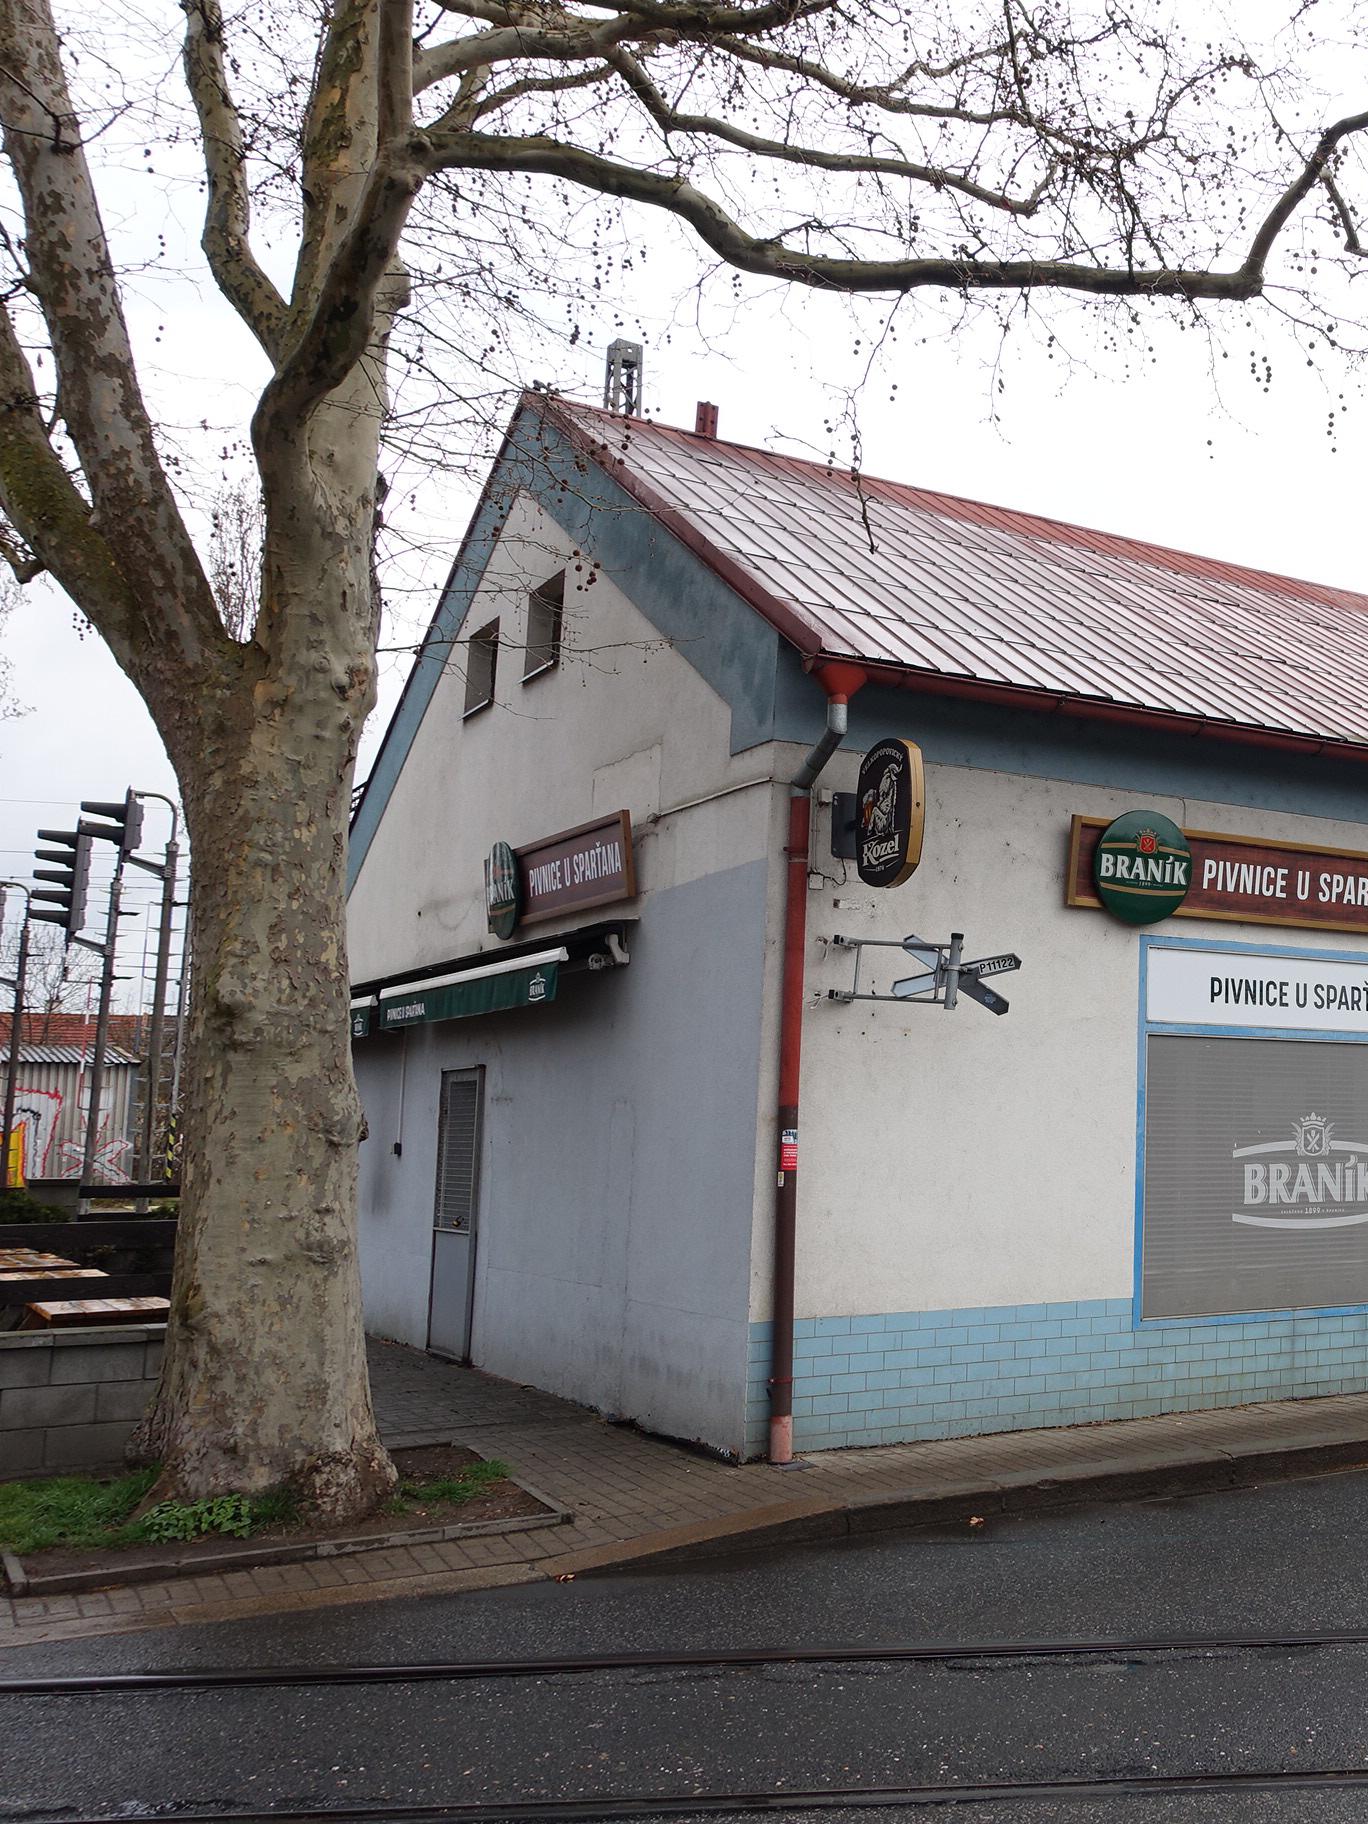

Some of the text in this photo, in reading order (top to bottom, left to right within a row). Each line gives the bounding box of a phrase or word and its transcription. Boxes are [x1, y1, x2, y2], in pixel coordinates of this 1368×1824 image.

[862, 834, 900, 867] Kozel
[529, 841, 622, 897] PIVNICE U SPARŤANA
[1100, 853, 1188, 885] BRANÍK
[1202, 858, 1289, 899] PIVNICE
[1297, 870, 1310, 901] U
[980, 957, 1014, 973] P11122
[1210, 976, 1289, 1008] PIVNICE
[1296, 982, 1308, 1008] U
